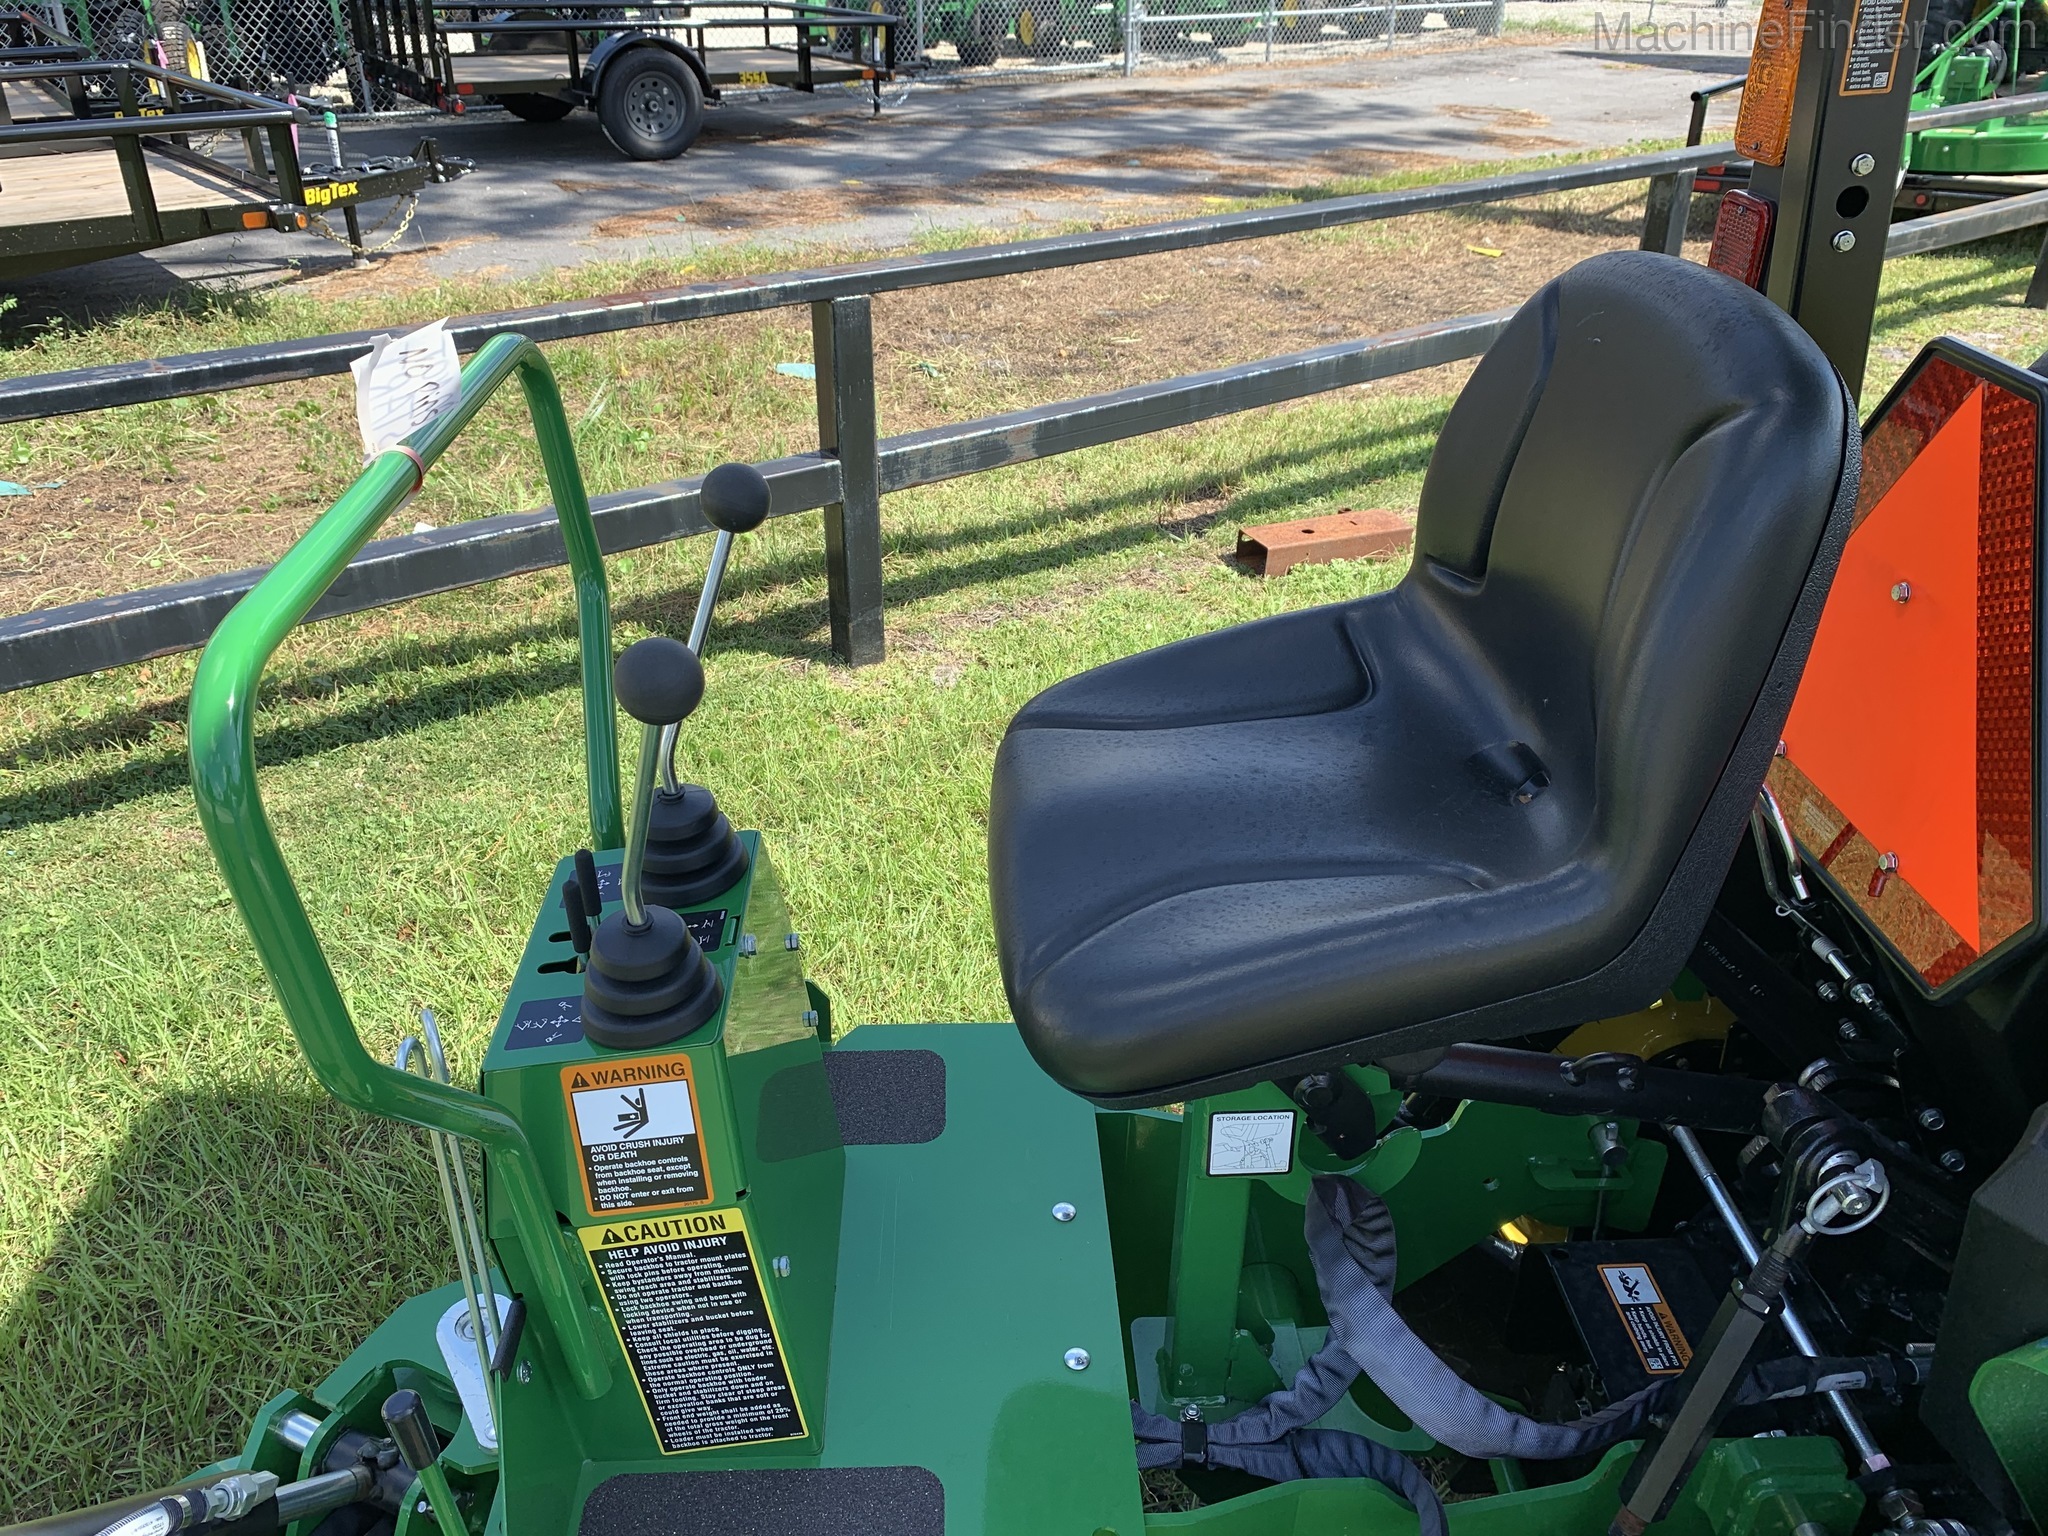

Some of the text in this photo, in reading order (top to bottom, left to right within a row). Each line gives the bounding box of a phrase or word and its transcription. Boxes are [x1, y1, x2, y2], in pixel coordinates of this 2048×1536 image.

[304, 181, 358, 206] BigTex
[591, 1062, 685, 1085] WARNING
[591, 1136, 684, 1153] AVOID CRUSH INJURY
[592, 1150, 637, 1162] OR DEATH
[594, 1156, 688, 1172] Operate backhoe controls
[614, 1169, 645, 1177] backhoe
[666, 1163, 691, 1171] except
[618, 1176, 652, 1184] installing
[664, 1170, 698, 1179] removing
[598, 1186, 632, 1194] backhoe.
[613, 1192, 629, 1200] NOT
[624, 1214, 726, 1241] CAUTION
[608, 1236, 726, 1260] HELP AVOID INJURY
[626, 1256, 664, 1266] Operator's
[665, 1252, 696, 1260] Manual.
[634, 1263, 664, 1271] backhoe
[700, 1255, 723, 1263] mount
[724, 1253, 746, 1261] plates
[632, 1276, 672, 1285] bystanders
[713, 1266, 748, 1274] maximum
[644, 1270, 660, 1278] pins
[687, 1263, 724, 1271] operating.
[693, 1275, 734, 1283] stabilizers.
[642, 1289, 669, 1297] operate
[655, 1293, 692, 1301] operators.
[640, 1302, 670, 1310] backhoe
[646, 1312, 692, 1321] transporting.
[652, 1319, 689, 1327] stabilizers
[1626, 1312, 1649, 1353] and clothing away
[1631, 1311, 1639, 1323] Keep
[1645, 1340, 1653, 1349] feet
[1645, 1306, 1679, 1366] AVOID INJURY FROM PTO
[634, 1340, 662, 1348] Consult
[1639, 1311, 1648, 1322] Keep
[1648, 1330, 1660, 1346] shields
[1659, 1353, 1669, 1366] place
[1663, 1320, 1691, 1362] WARNING
[689, 1376, 722, 1384] operating
[724, 1372, 754, 1380] position.
[708, 1367, 736, 1375] controls
